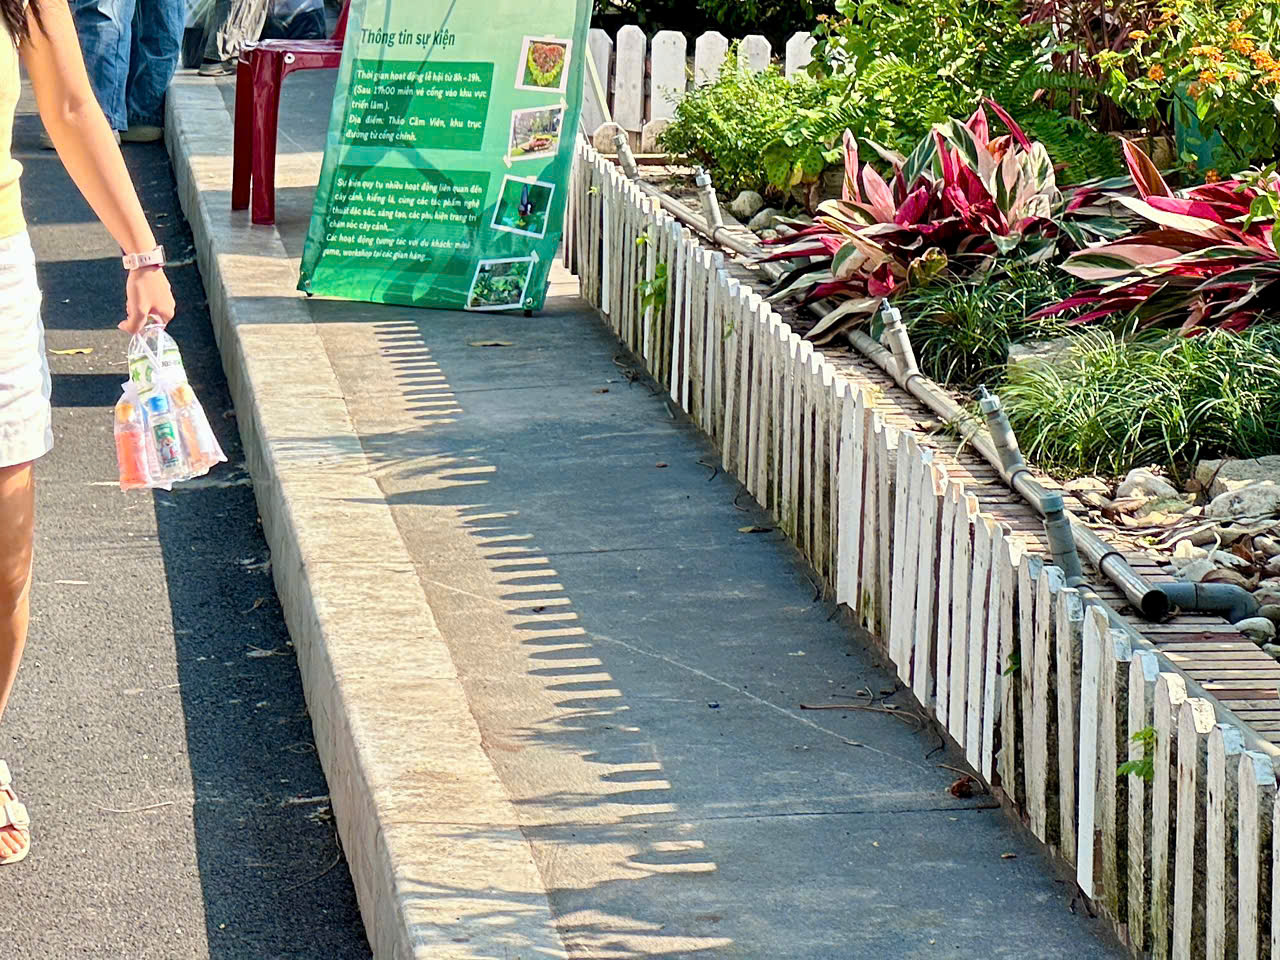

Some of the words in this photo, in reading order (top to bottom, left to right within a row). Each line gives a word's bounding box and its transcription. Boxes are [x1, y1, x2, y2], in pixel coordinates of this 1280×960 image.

[361, 28, 396, 48] Thông
[399, 29, 413, 44] tin
[416, 33, 431, 49] sự
[433, 29, 455, 49] kiện
